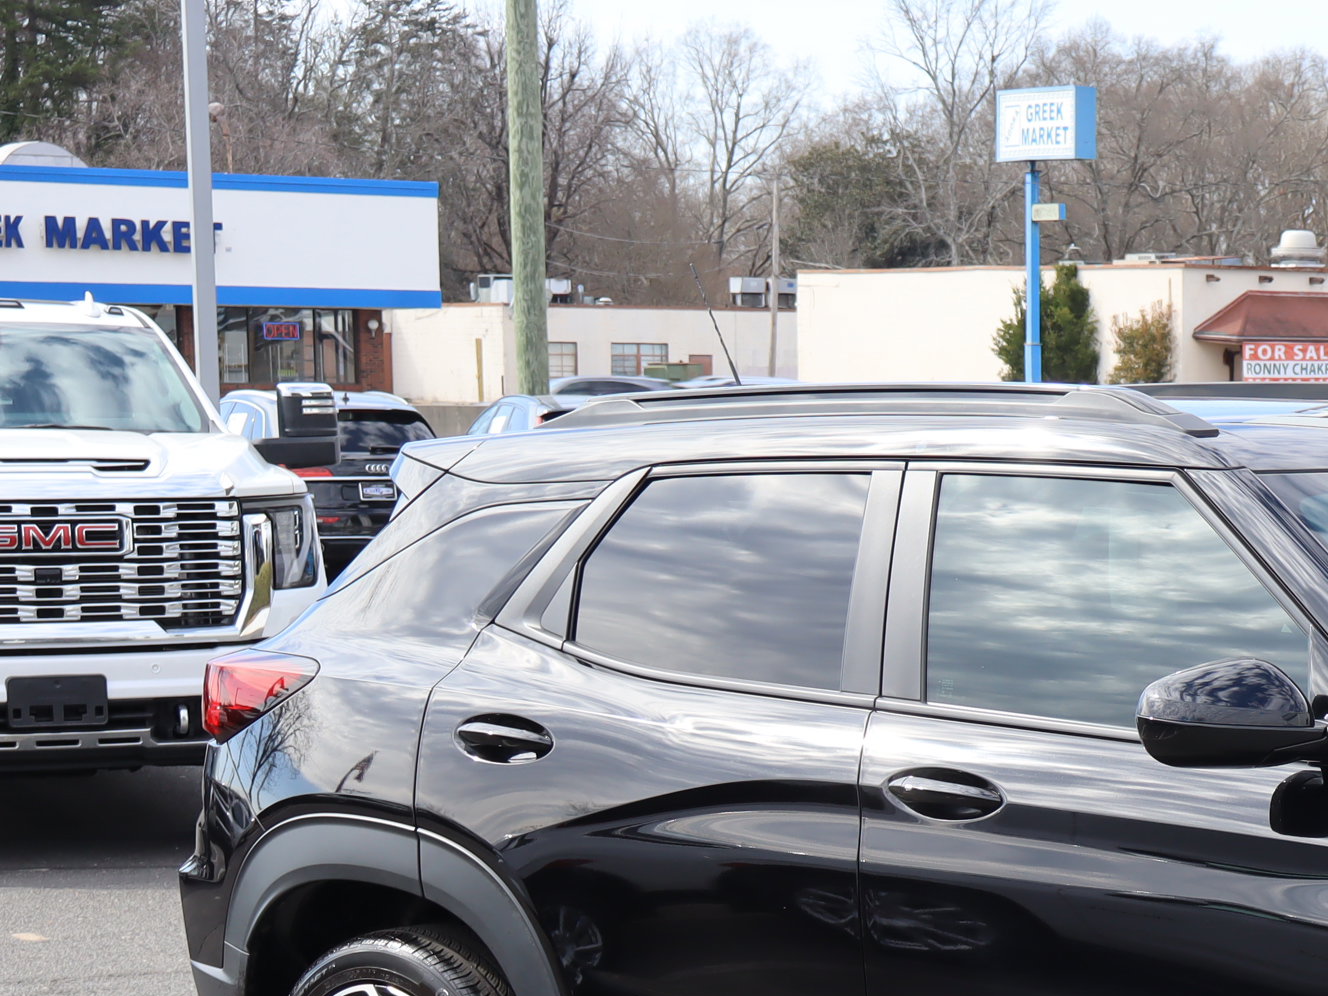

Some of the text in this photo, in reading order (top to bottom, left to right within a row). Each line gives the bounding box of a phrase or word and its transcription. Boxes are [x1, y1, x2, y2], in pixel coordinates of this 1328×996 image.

[1026, 102, 1063, 122] GREEK
[1021, 126, 1069, 145] MARKET
[0, 215, 24, 249] K
[266, 323, 298, 339] OPEN
[1244, 344, 1287, 360] FOR
[1246, 363, 1289, 375] RONNY
